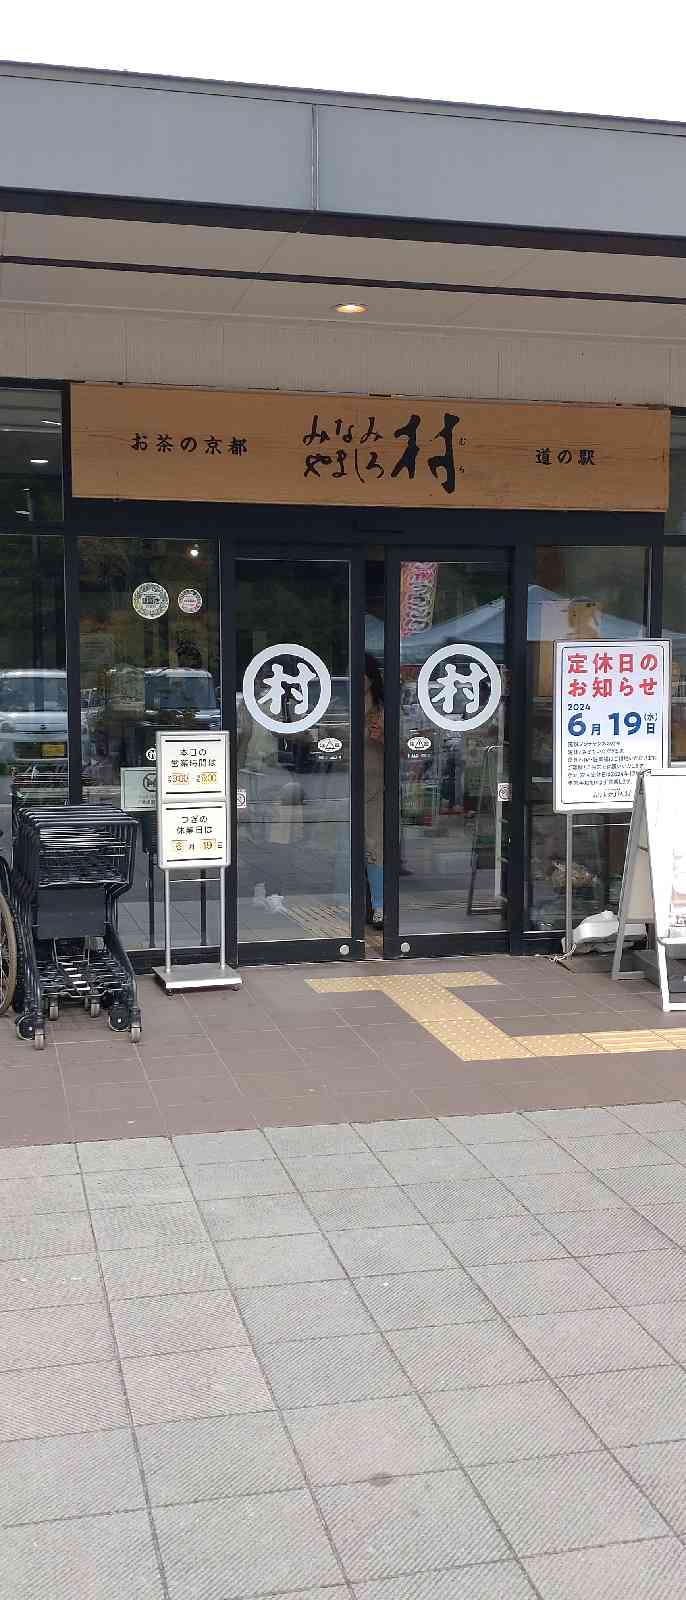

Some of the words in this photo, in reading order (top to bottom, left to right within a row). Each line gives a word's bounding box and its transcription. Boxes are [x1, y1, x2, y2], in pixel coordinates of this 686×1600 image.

[131, 432, 248, 456] お茶の京都
[302, 414, 384, 446] みなみ
[303, 448, 386, 484] やましろ
[390, 412, 461, 495] 村
[535, 447, 597, 466] 道の駅
[567, 652, 658, 674] 定休日の
[257, 662, 318, 715] 村
[431, 662, 489, 714] 村
[567, 676, 658, 698] お知らせ
[567, 703, 591, 711] 2024
